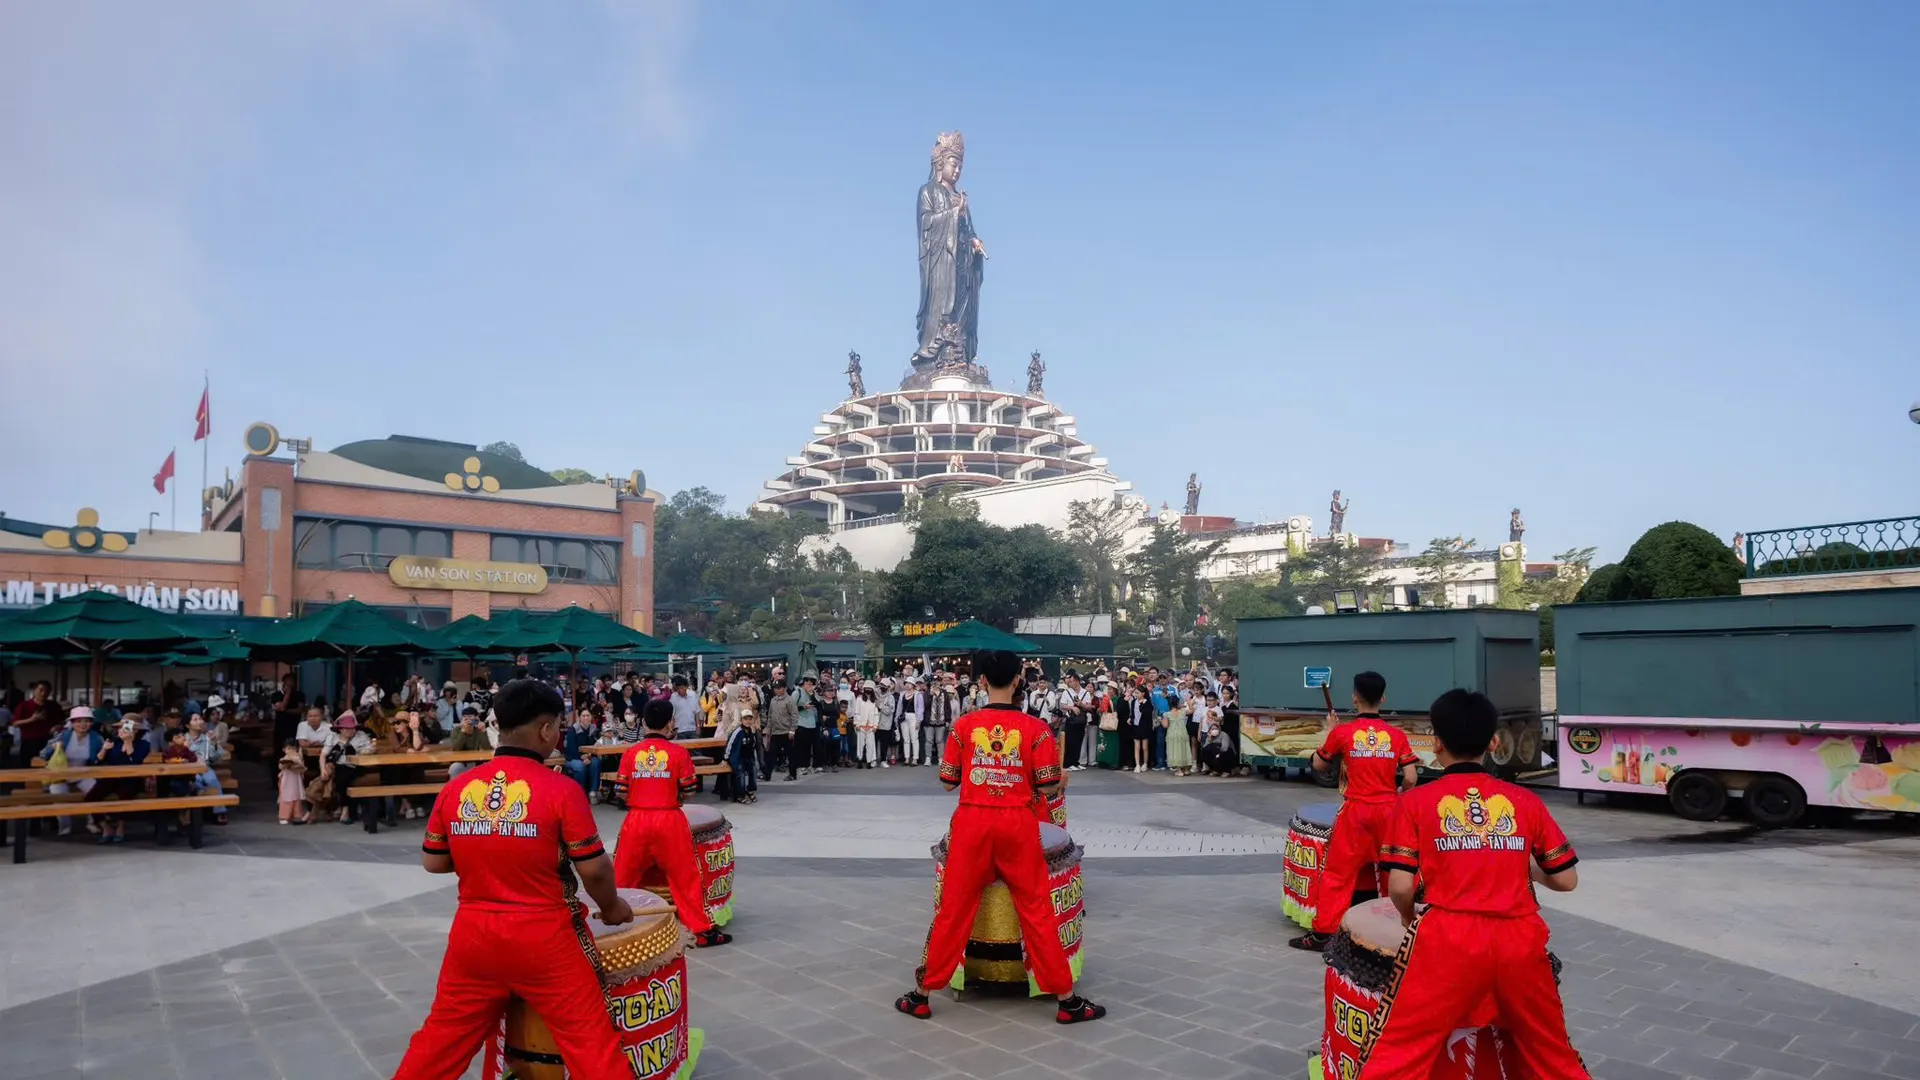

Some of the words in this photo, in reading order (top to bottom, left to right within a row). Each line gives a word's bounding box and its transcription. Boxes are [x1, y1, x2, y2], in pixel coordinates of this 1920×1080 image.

[405, 565, 436, 579] VAN
[439, 567, 470, 582] SON
[474, 569, 538, 584] STATION
[126, 581, 180, 610] VÂN
[184, 587, 239, 612] SƠN
[1487, 832, 1504, 850] TÂY
